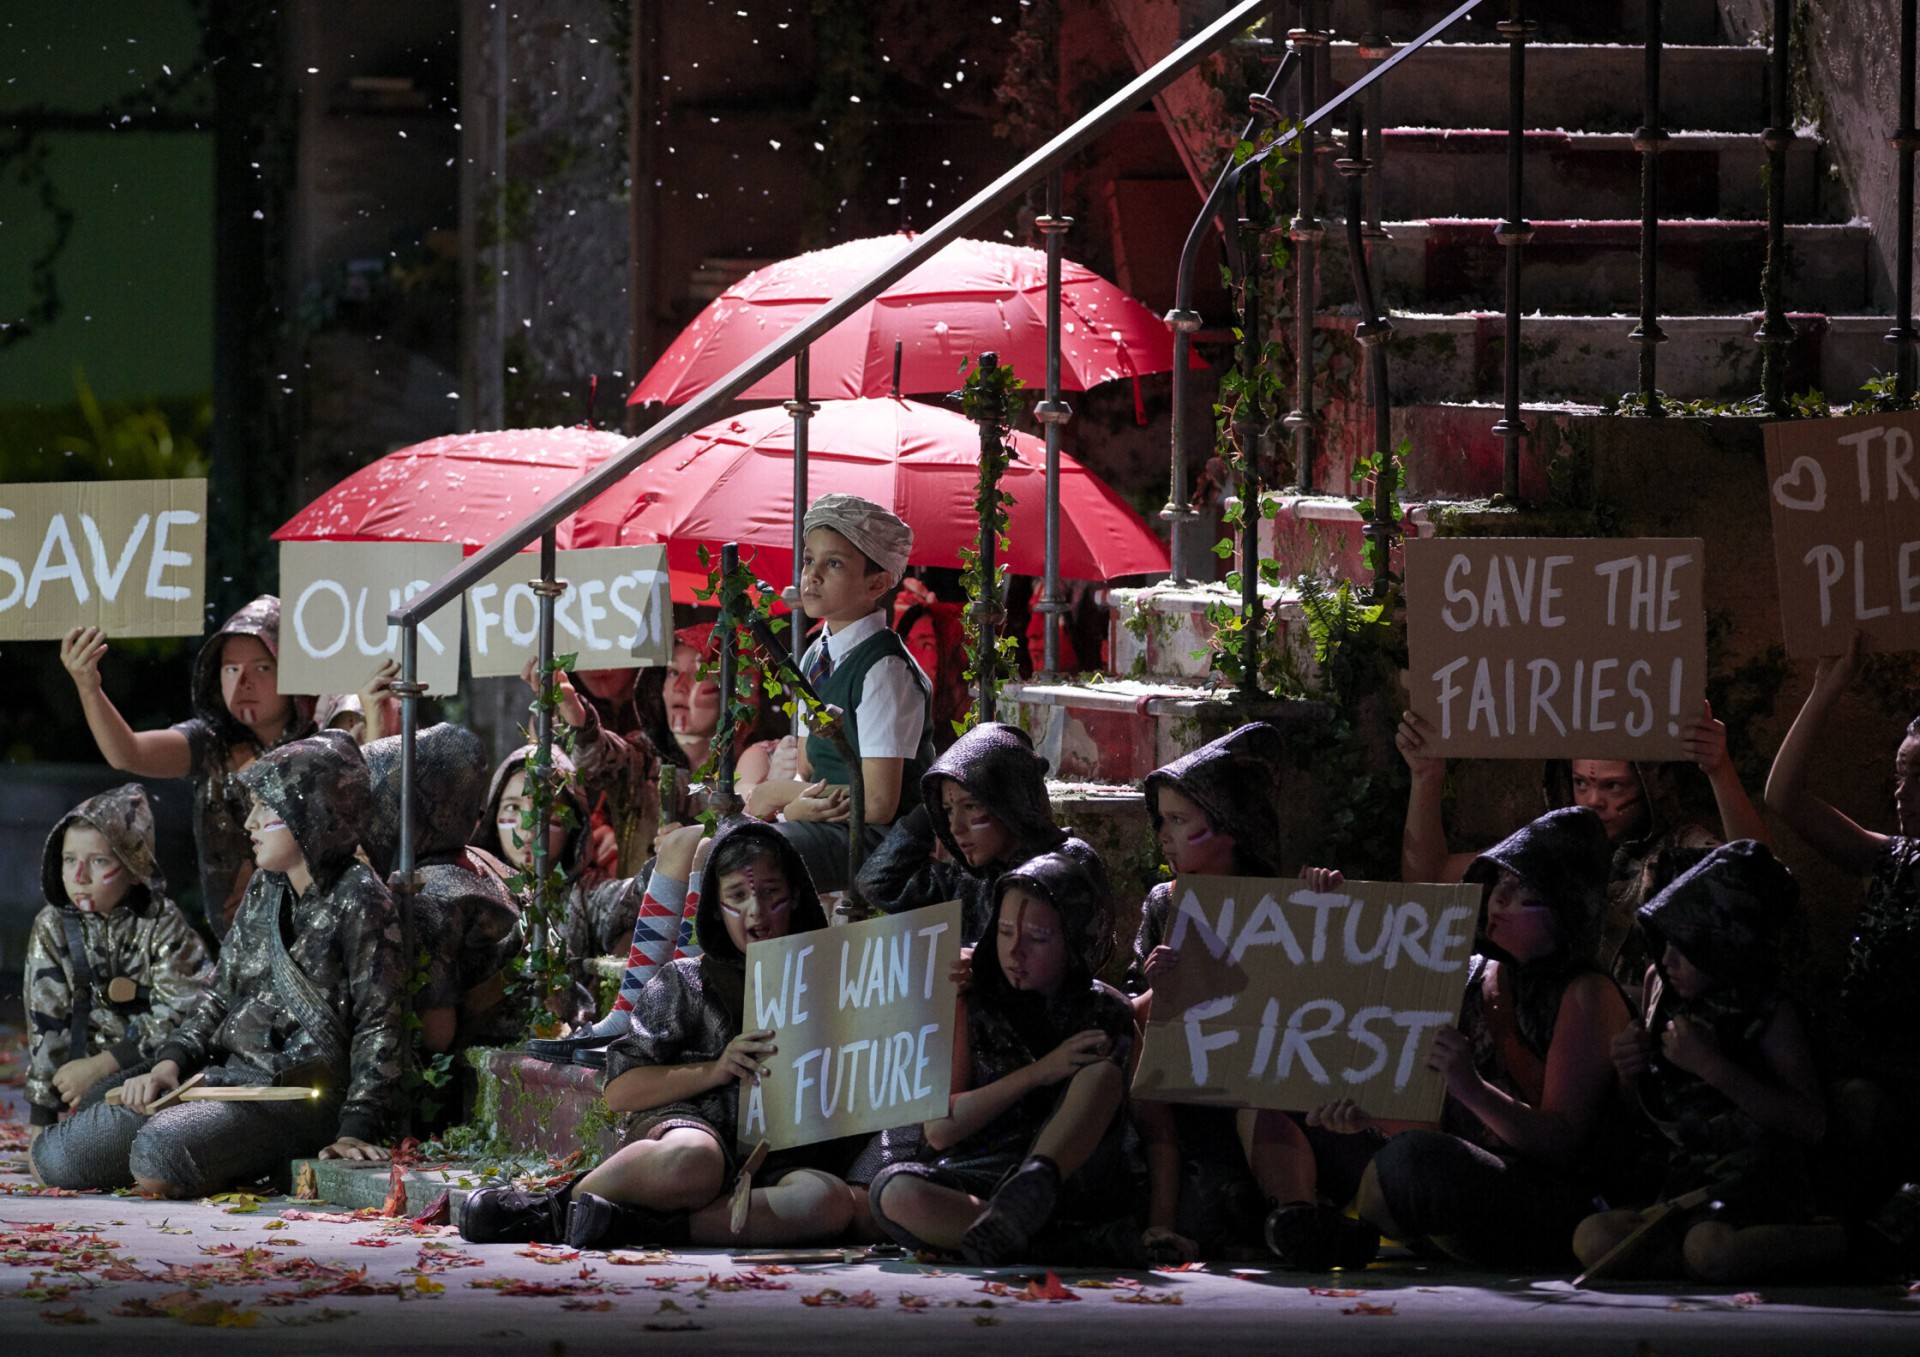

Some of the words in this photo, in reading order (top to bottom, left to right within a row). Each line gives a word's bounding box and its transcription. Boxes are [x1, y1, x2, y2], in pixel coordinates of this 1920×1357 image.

[1838, 426, 1920, 503] TR
[0, 508, 200, 612] SAVE
[1441, 553, 1574, 632] SAVE
[1595, 554, 1693, 633] THE
[1432, 656, 1683, 739] FAIRIES!
[754, 944, 815, 1030] WE
[838, 922, 949, 1011] WANT
[1168, 888, 1473, 973] NATURE
[745, 1072, 766, 1136] A
[792, 1023, 940, 1125] FUTURE
[1184, 995, 1453, 1094] FIRST
